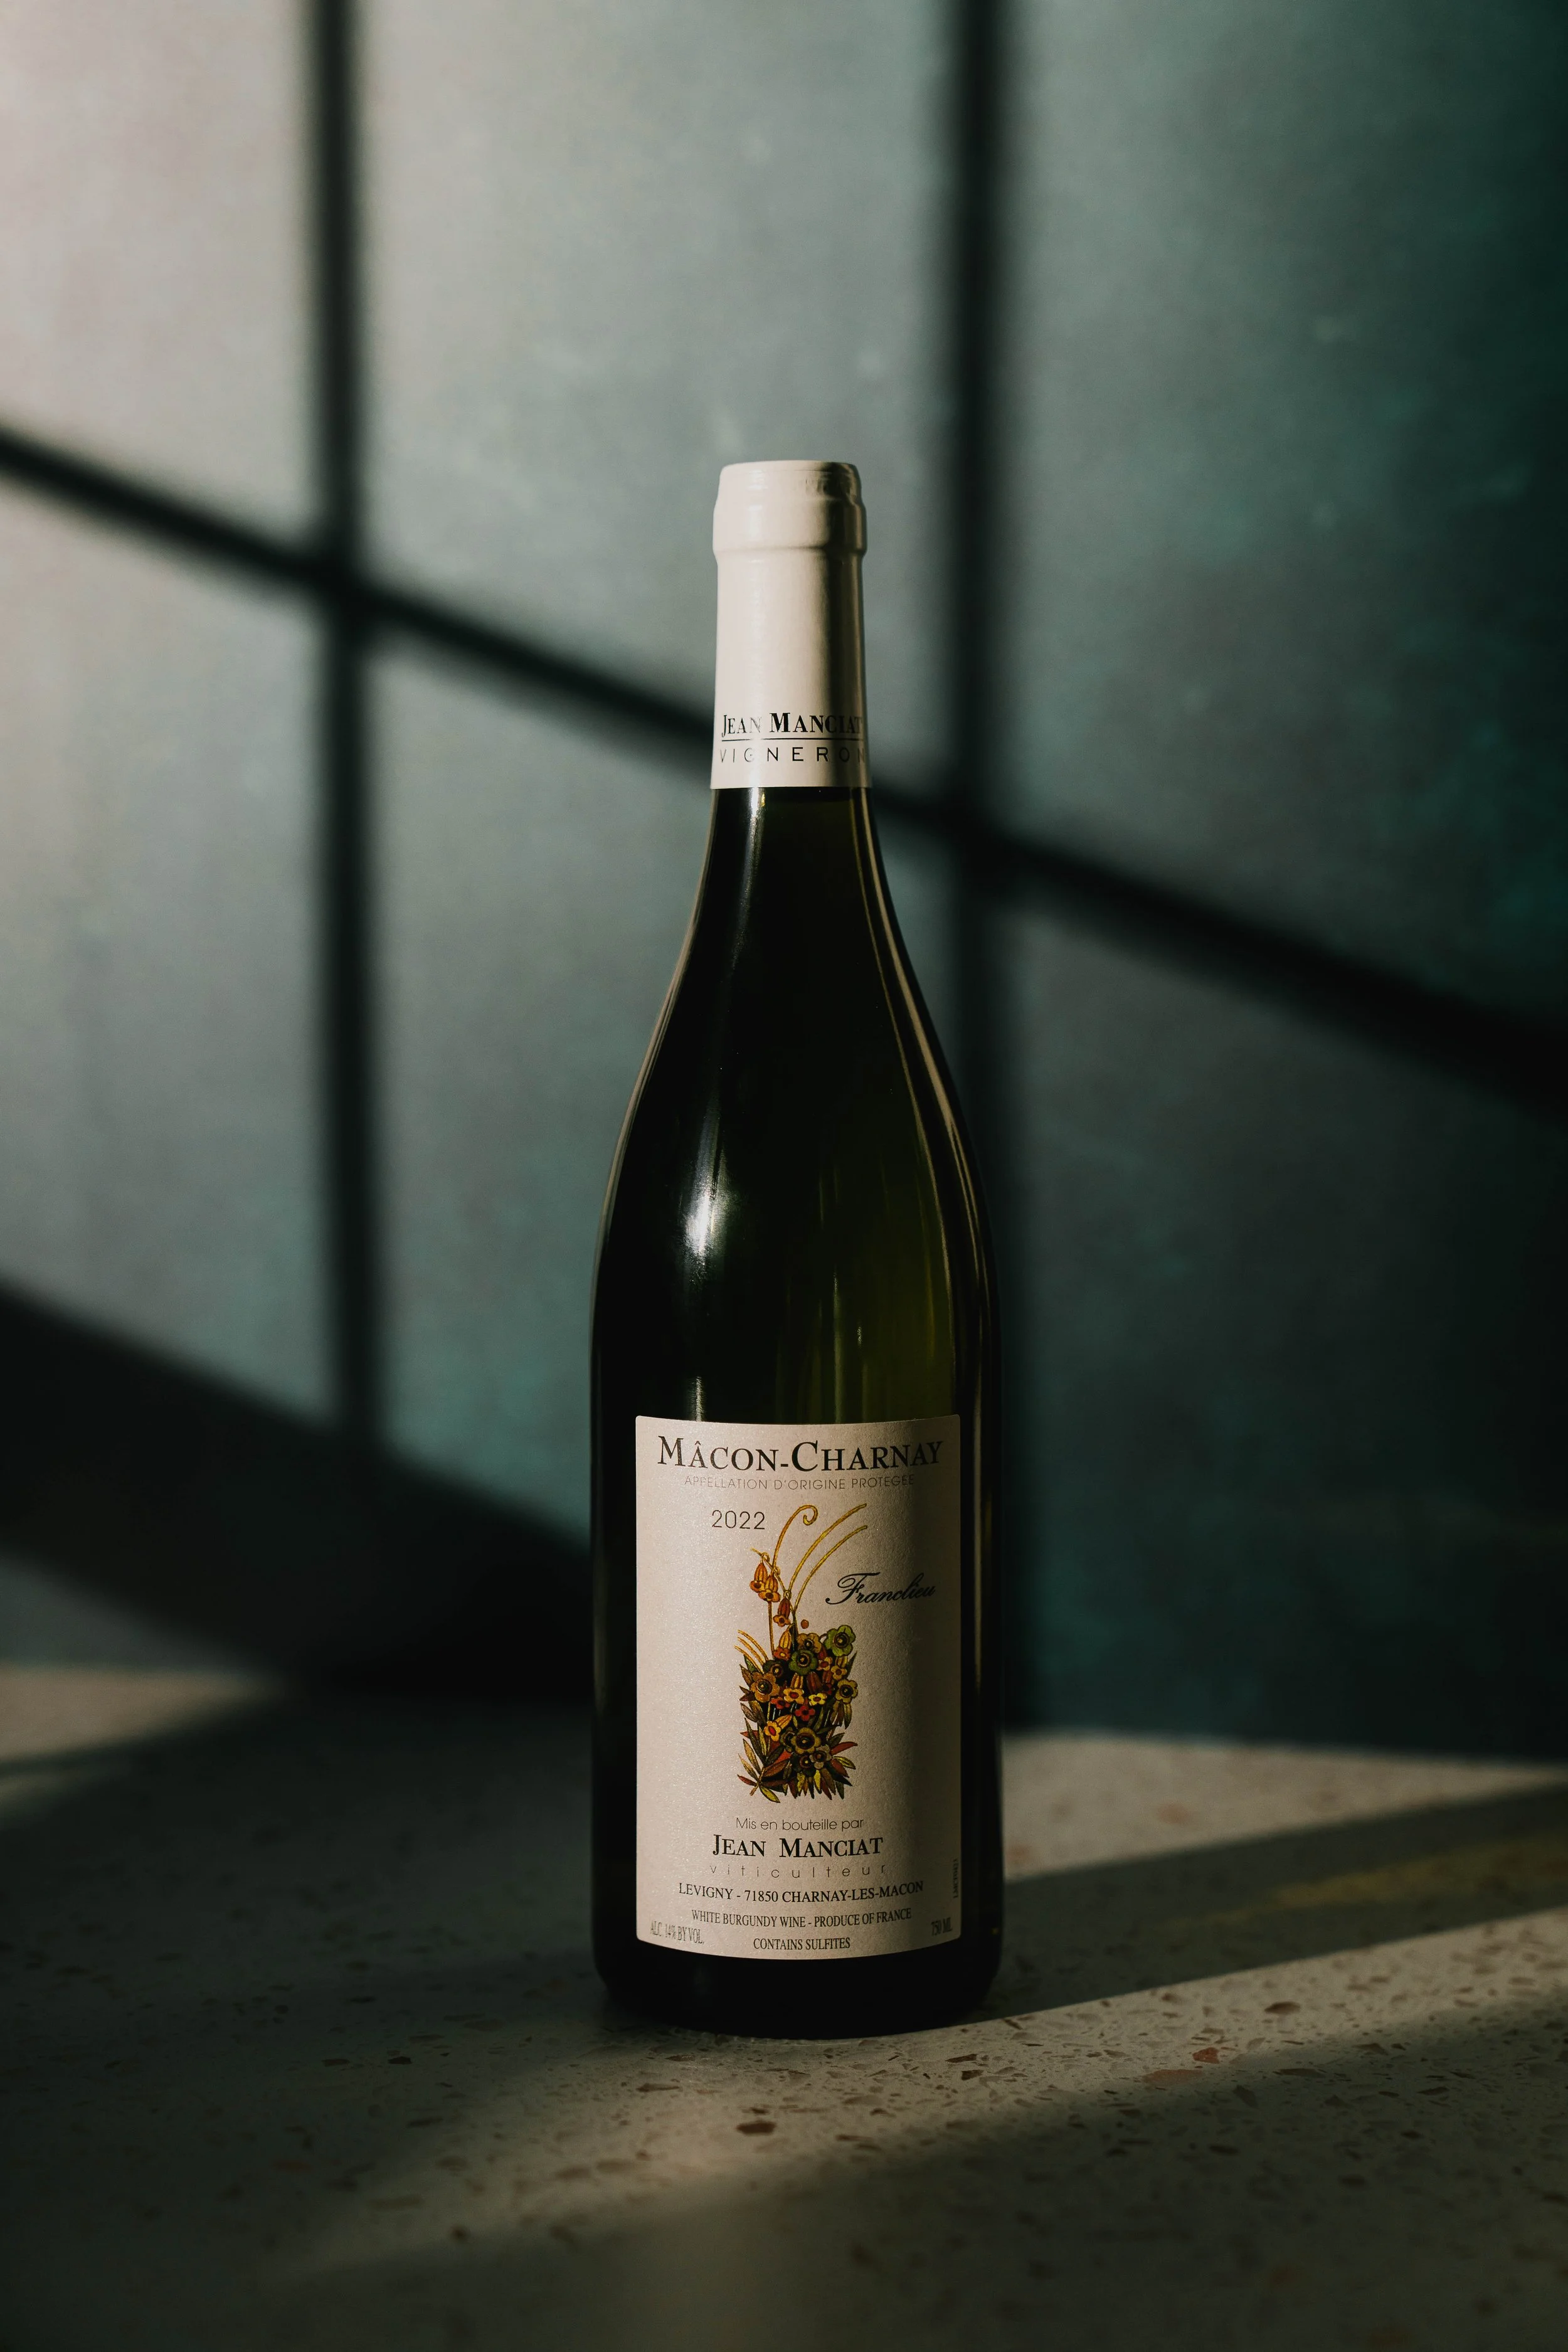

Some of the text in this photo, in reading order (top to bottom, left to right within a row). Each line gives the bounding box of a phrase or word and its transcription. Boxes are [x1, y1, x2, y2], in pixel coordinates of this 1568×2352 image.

[721, 712, 863, 738] JEAN MANCIAT
[720, 746, 865, 763] VIGNERON
[657, 1435, 943, 1472] MÂCON-CHARNAY
[684, 1476, 768, 1490] APPELLATION
[774, 1480, 845, 1490] D'ORIGINE
[711, 1509, 765, 1530] 2022
[736, 1818, 864, 1832] Mis en bouteille par
[712, 1834, 883, 1858] JEAN MANCIAT
[710, 1864, 886, 1878] viticulteur
[679, 1883, 733, 1900] LEVIGNY
[744, 1890, 778, 1902] 71850
[781, 1880, 924, 1903] CHARNAY-LES-MACON
[692, 1910, 721, 1924] WHITE
[723, 1914, 777, 1927] BURGUNDY
[780, 1916, 806, 1928] WINE
[815, 1914, 860, 1927] PRODUCE
[862, 1913, 875, 1925] OF
[876, 1908, 912, 1924] FRANCE
[677, 1926, 687, 1942] BY
[753, 1937, 851, 1951] CONTAINS SULFITES
